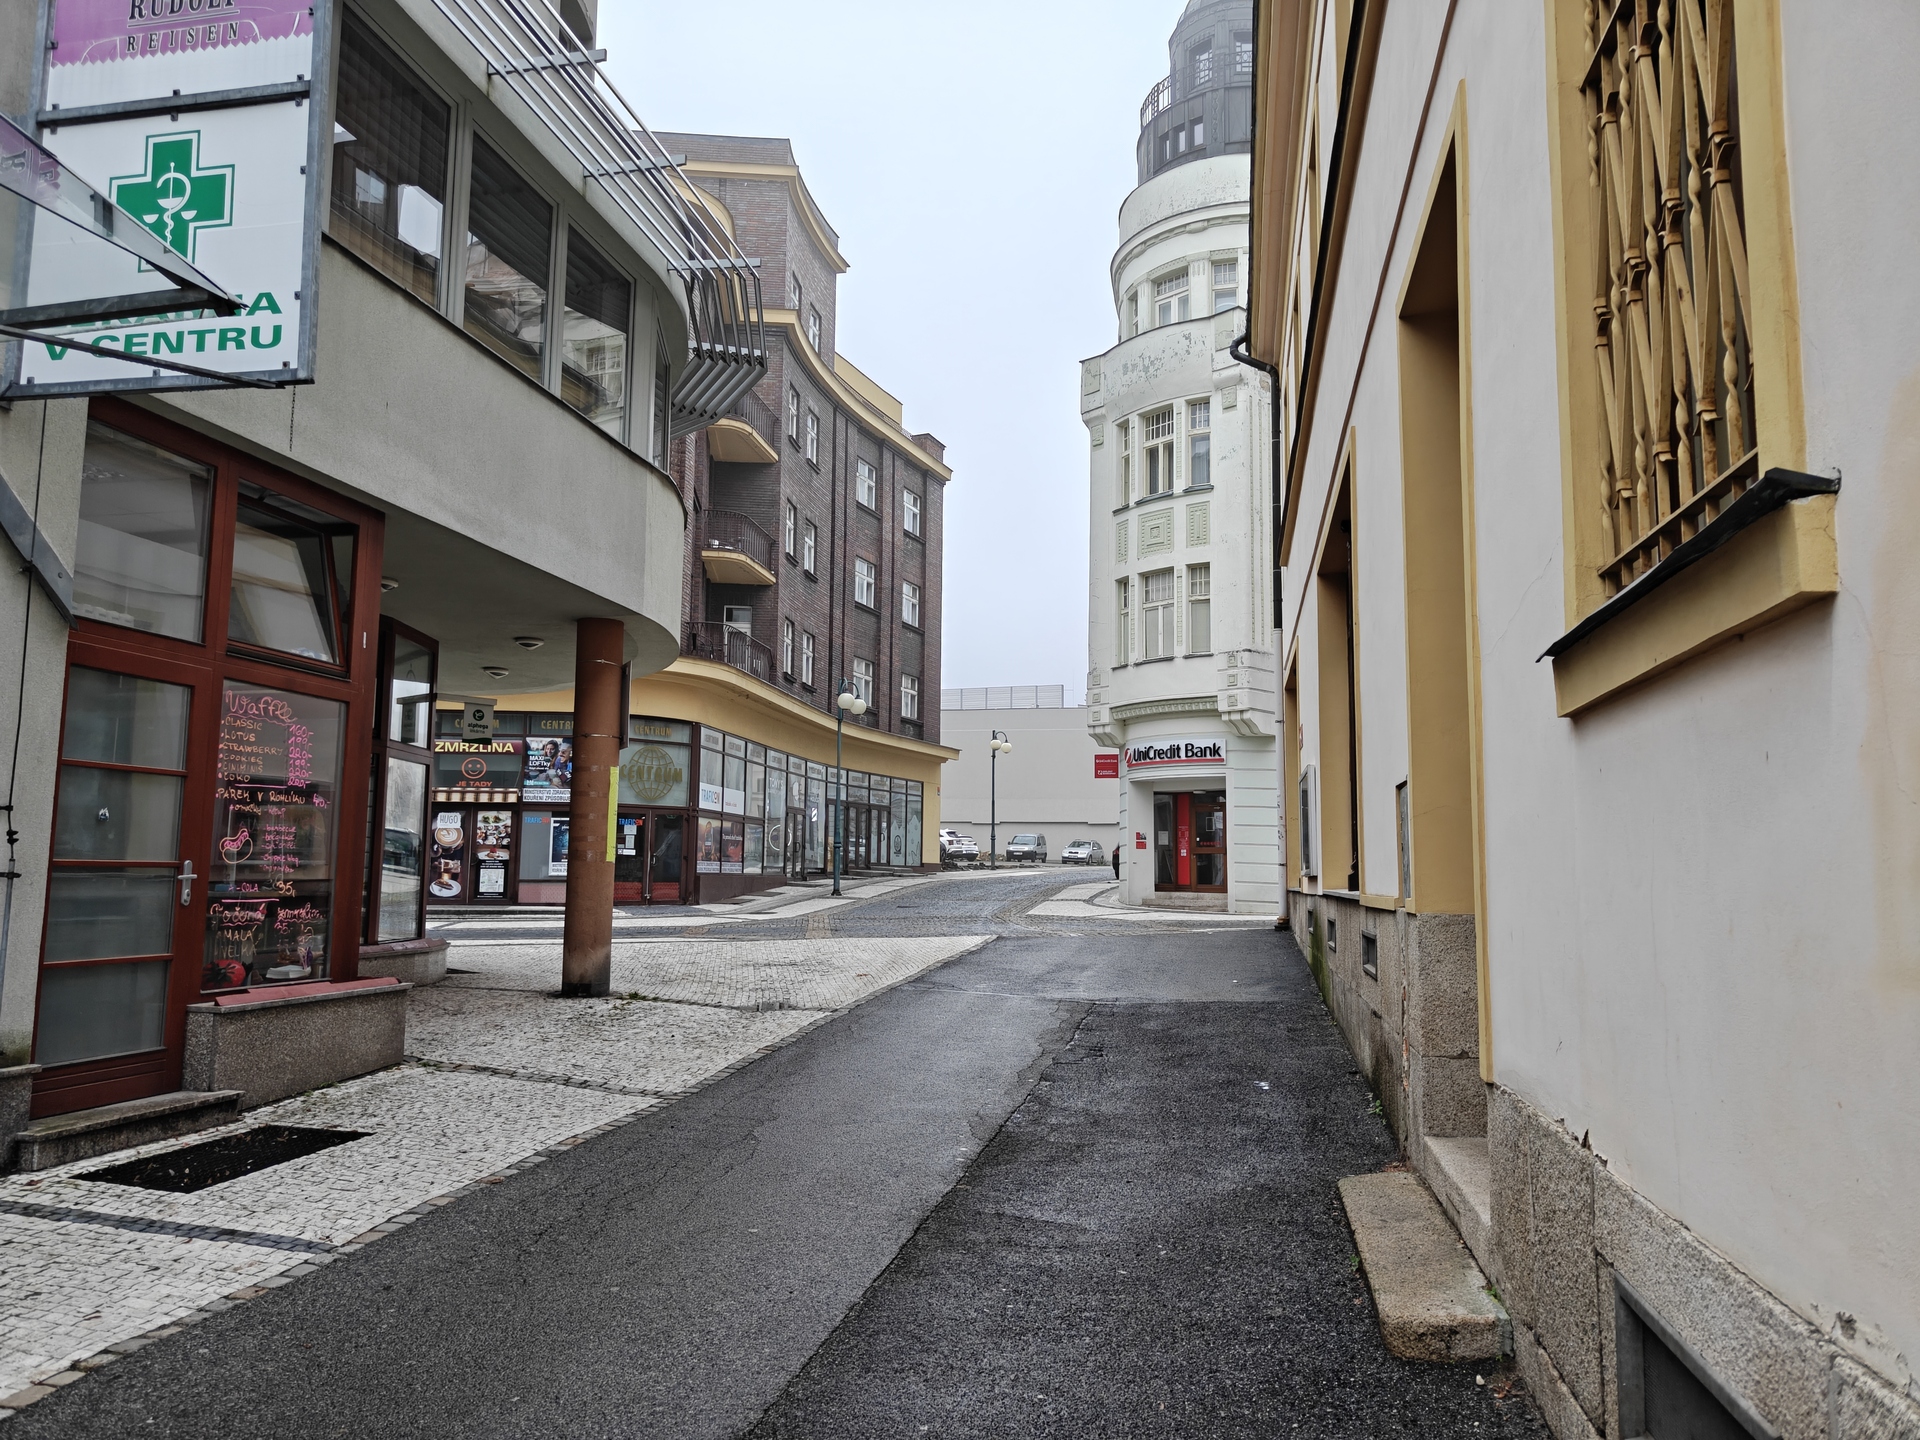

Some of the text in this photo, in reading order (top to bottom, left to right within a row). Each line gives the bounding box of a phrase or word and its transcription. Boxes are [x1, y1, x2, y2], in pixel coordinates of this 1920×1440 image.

[126, 22, 239, 52] REISEN
[91, 324, 283, 359] CENTRU
[225, 717, 263, 731] CLASSIC
[467, 722, 489, 730] alphega
[541, 720, 574, 730] CENTR
[224, 729, 256, 742] LOTUS
[635, 725, 672, 737] CENTRUM
[221, 742, 284, 756] STRAWBERRY
[434, 742, 515, 753] ZMRZLINA
[1133, 742, 1222, 762] UniCredit Bank
[223, 754, 263, 765] COOKIES
[223, 771, 251, 783] ČOKO
[620, 764, 683, 784] CENTRUM
[217, 786, 251, 802] PÁREK
[439, 815, 459, 824] HUGO
